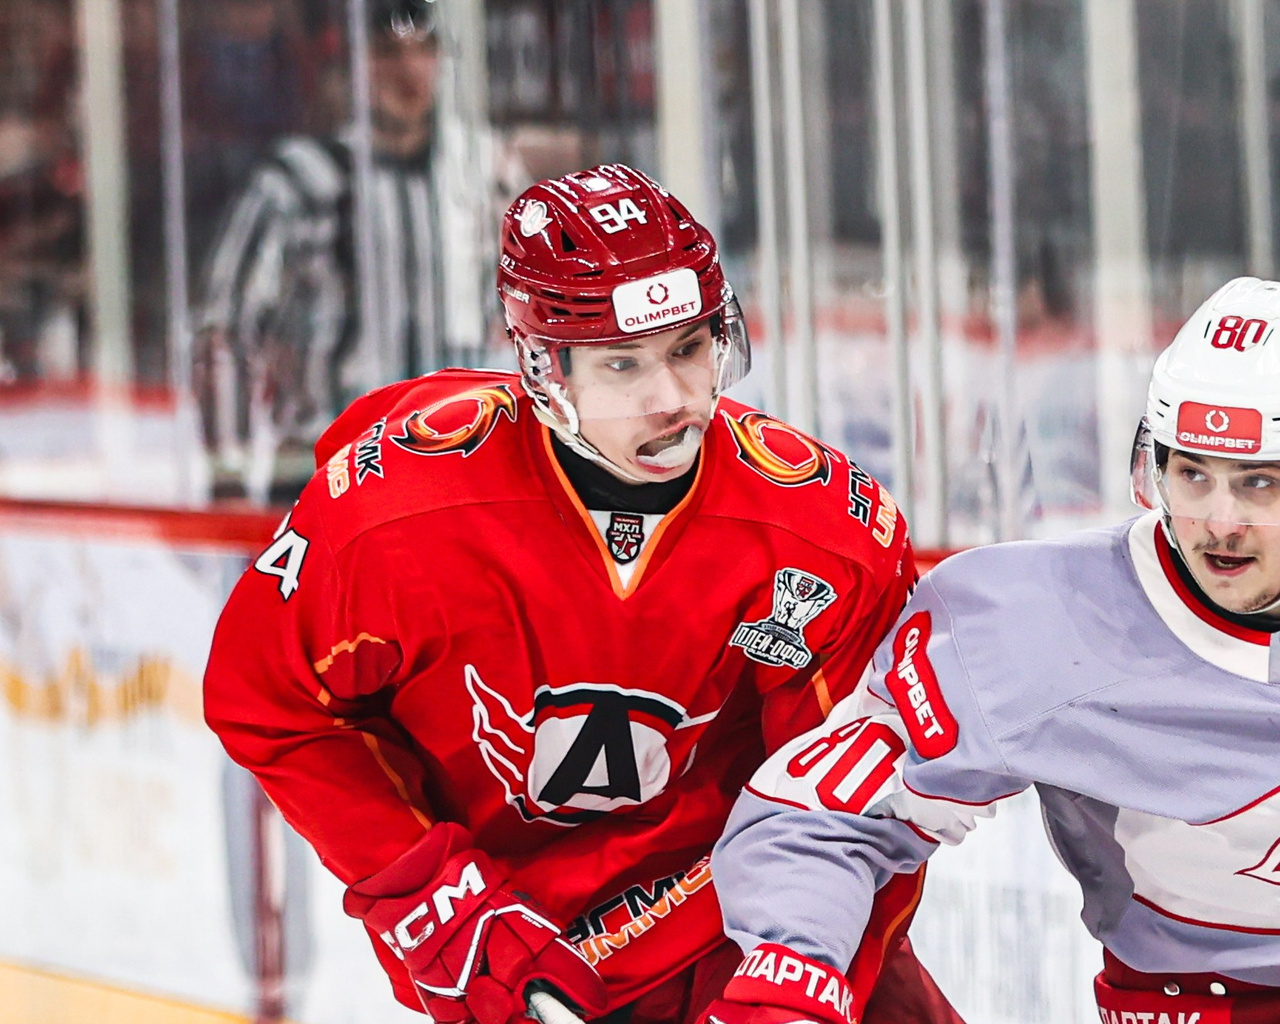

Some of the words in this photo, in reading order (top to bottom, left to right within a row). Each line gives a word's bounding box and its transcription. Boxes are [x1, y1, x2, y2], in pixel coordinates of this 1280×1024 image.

[589, 198, 648, 235] 94
[624, 301, 697, 328] OLIMPBET
[1211, 315, 1268, 352] 80
[1178, 430, 1257, 451] OLIMPBET
[613, 522, 640, 534] МХЛ
[254, 501, 310, 603] 4
[733, 626, 808, 666] ПЛЕЙ-ОФФ
[786, 716, 909, 816] 80
[734, 949, 858, 1024] ПАРТАК
